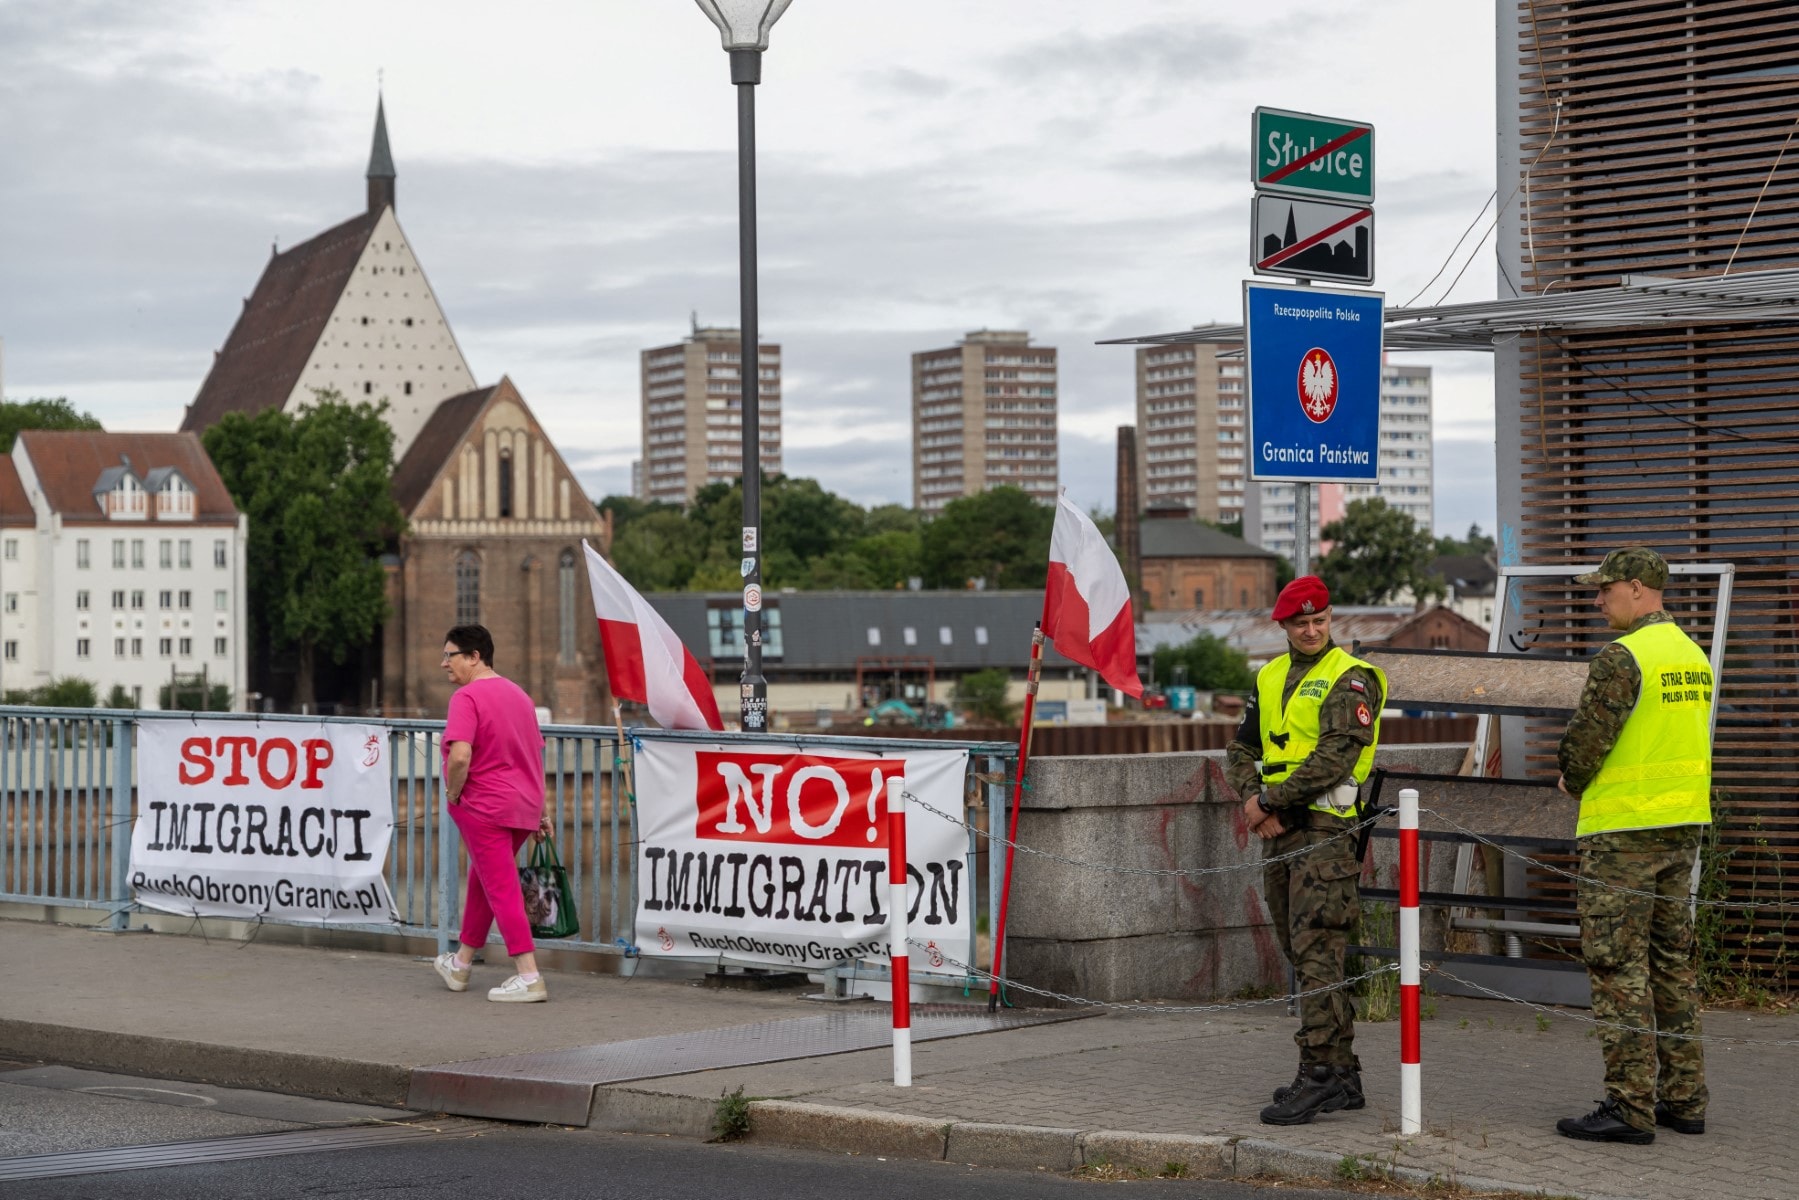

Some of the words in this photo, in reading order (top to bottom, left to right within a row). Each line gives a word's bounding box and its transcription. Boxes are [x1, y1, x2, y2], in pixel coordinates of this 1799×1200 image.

[1266, 131, 1363, 178] Słubice
[1274, 303, 1333, 321] Rzeczpospolita
[1336, 308, 1360, 321] Polska
[1262, 441, 1314, 463] Granica
[1319, 443, 1369, 465] Państwa
[179, 736, 334, 790] STOP
[715, 761, 884, 843] NO!
[147, 801, 372, 862] IMIGRACJI
